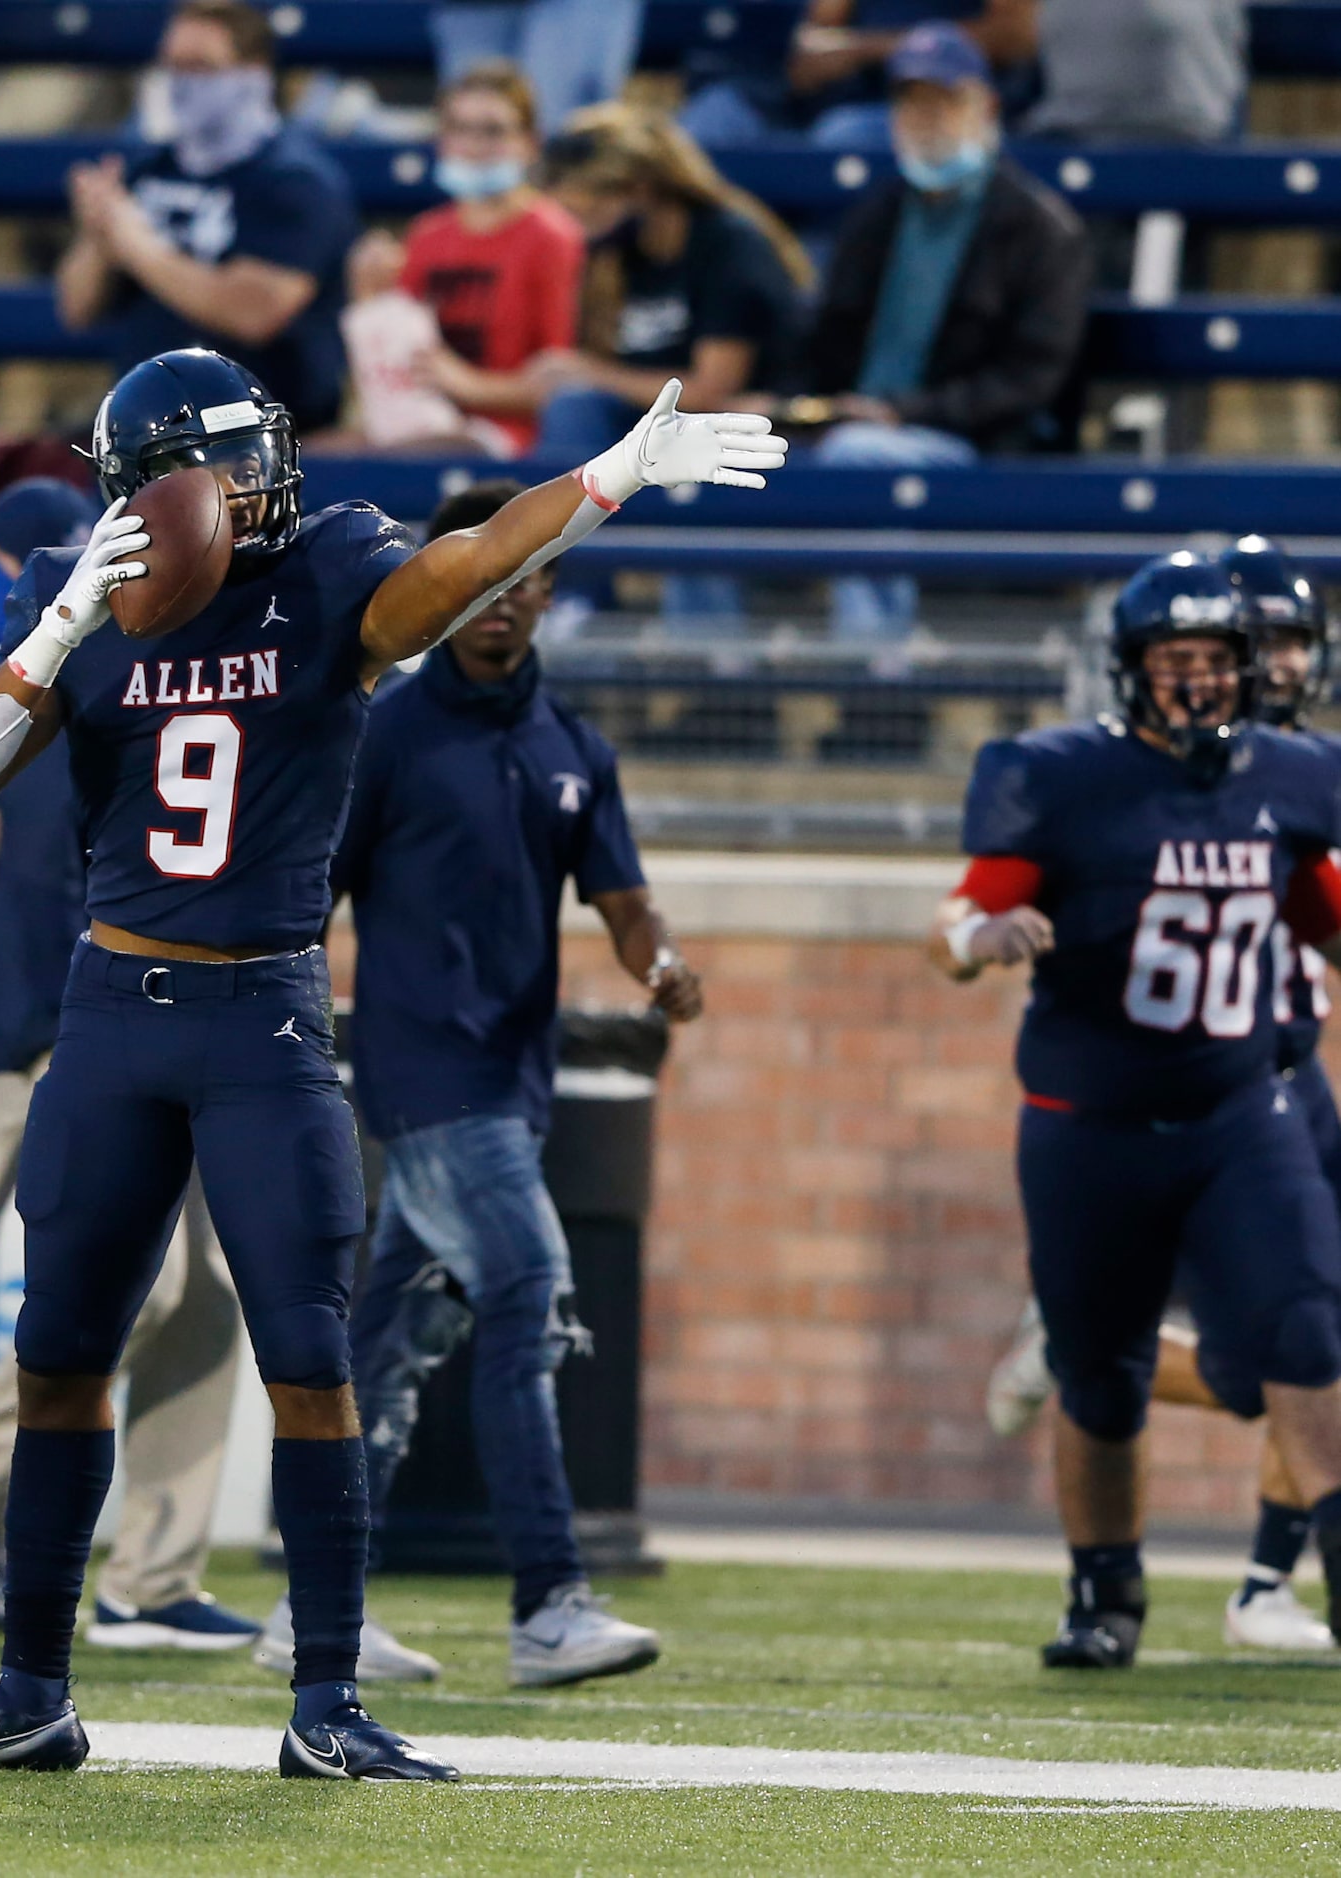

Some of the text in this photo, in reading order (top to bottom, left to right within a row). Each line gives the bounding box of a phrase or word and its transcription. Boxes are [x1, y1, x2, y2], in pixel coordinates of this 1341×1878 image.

[120, 649, 280, 707] ALLEN
[146, 710, 245, 880] 9
[1154, 840, 1271, 887] ALLEN
[1122, 888, 1277, 1039] 60
